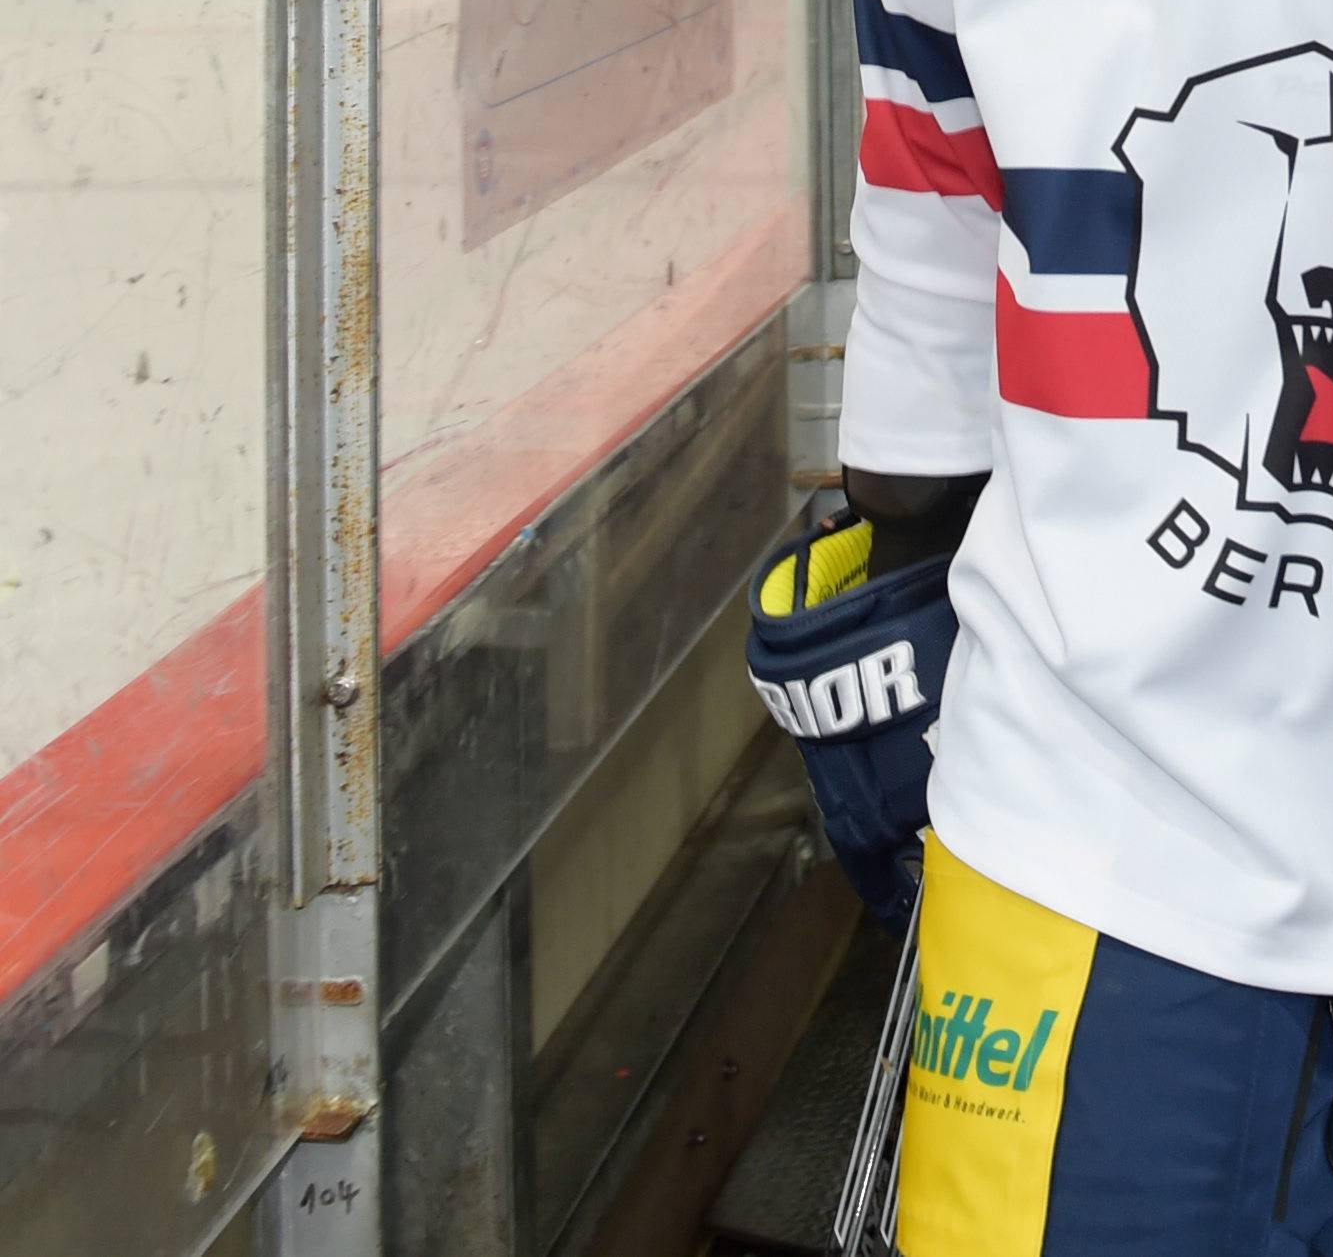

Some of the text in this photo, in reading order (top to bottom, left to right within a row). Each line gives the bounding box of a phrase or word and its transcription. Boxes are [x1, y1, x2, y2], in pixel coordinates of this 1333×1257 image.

[748, 639, 927, 739] RIOR
[911, 983, 1059, 1092] nittel
[300, 1180, 361, 1215] 104
